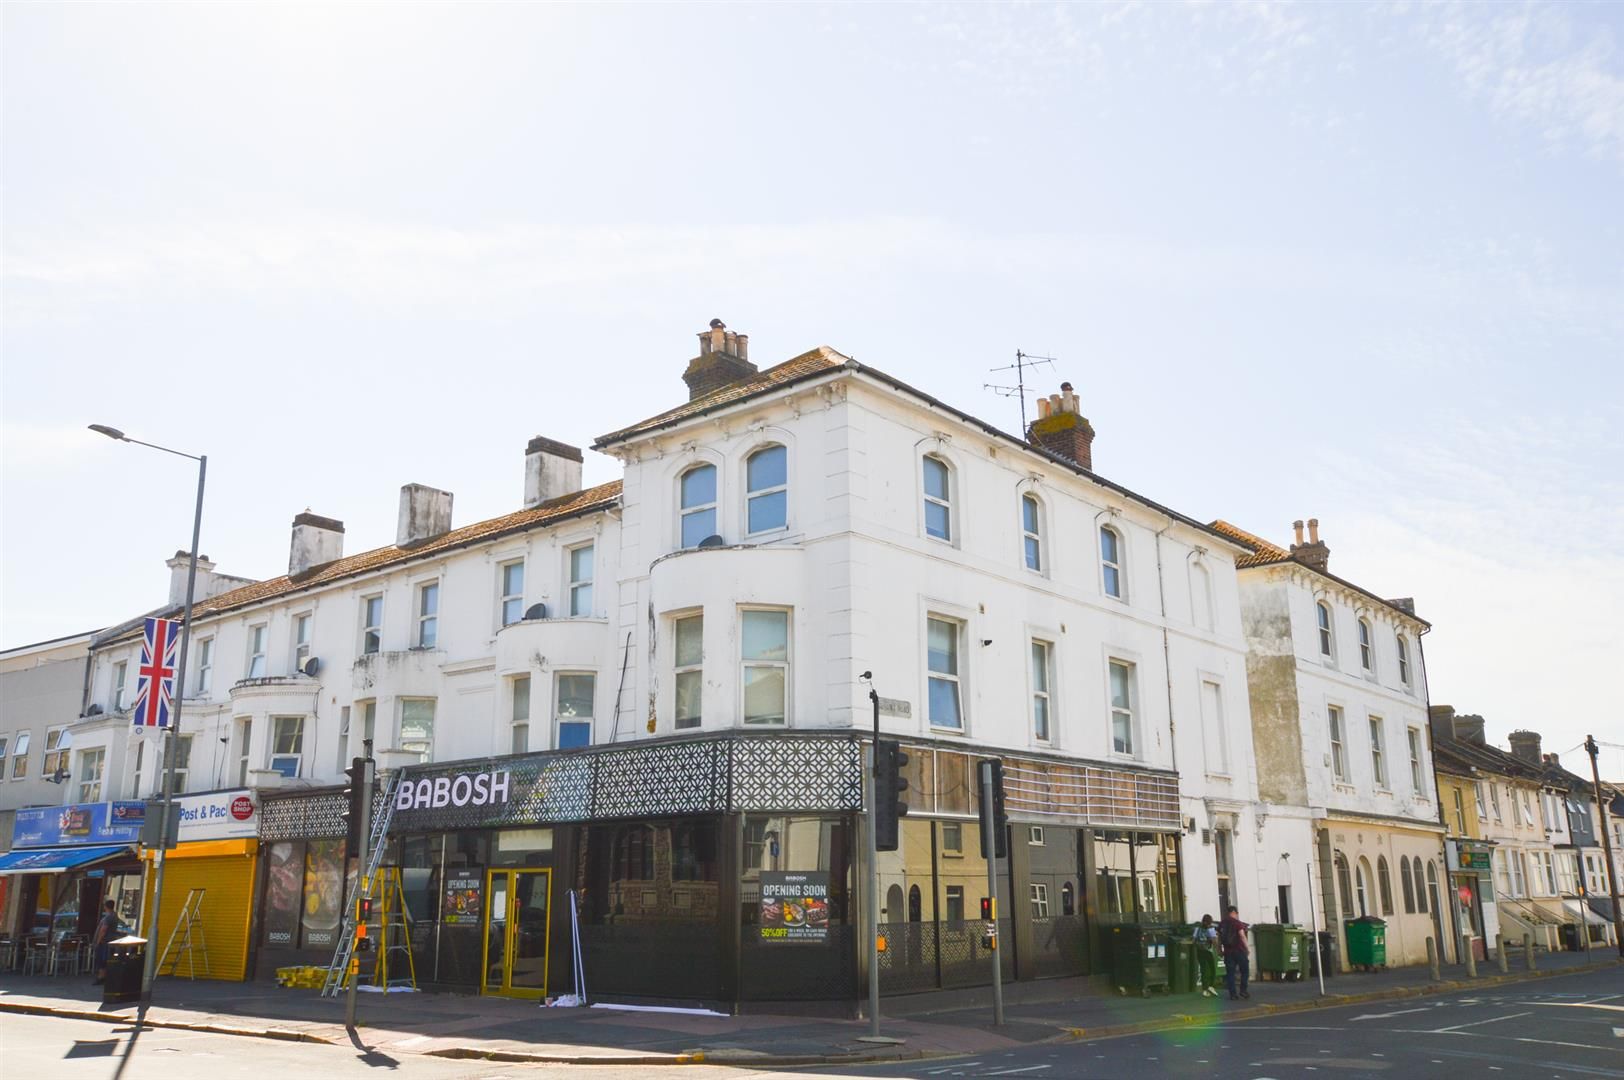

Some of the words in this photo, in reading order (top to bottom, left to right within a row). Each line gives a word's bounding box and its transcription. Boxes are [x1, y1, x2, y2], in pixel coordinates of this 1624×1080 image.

[396, 772, 510, 810] BABOSH
[179, 807, 198, 820] Post
[200, 805, 207, 819] &
[763, 885, 801, 896] OPENING
[803, 885, 827, 896] SOON
[269, 932, 291, 940] BABOSH
[308, 933, 331, 942] BABOSH
